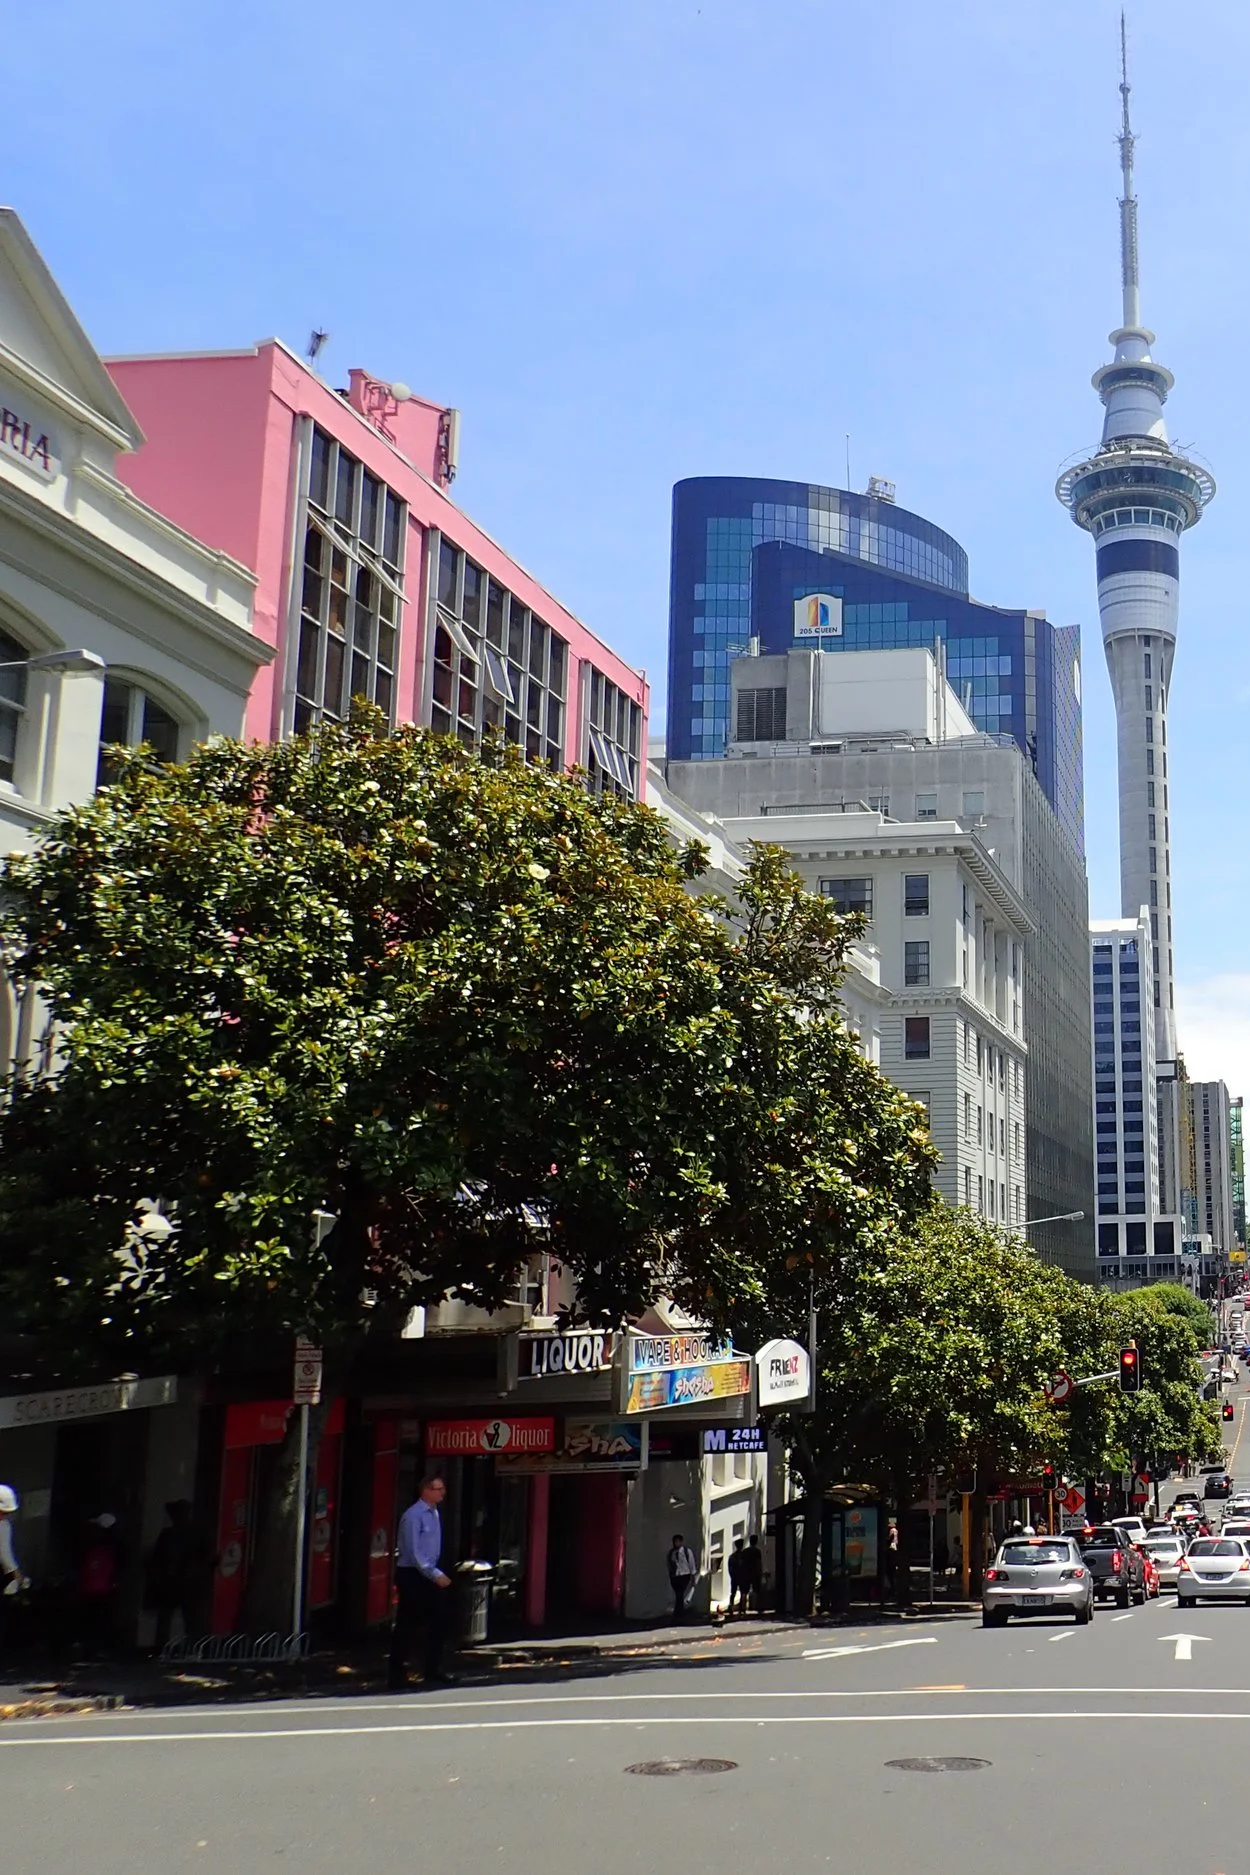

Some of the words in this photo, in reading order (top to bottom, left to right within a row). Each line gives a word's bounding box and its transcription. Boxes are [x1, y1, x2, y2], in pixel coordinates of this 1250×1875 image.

[531, 1335, 604, 1374] LIQUOR
[639, 1340, 671, 1365] VAPE
[673, 1340, 681, 1364] &
[429, 1426, 477, 1449] Victoria
[512, 1424, 550, 1449] liquor
[704, 1430, 725, 1451] M
[732, 1429, 760, 1440] 24H
[728, 1441, 764, 1450] NETCAFE
[1056, 1490, 1066, 1498] 30
